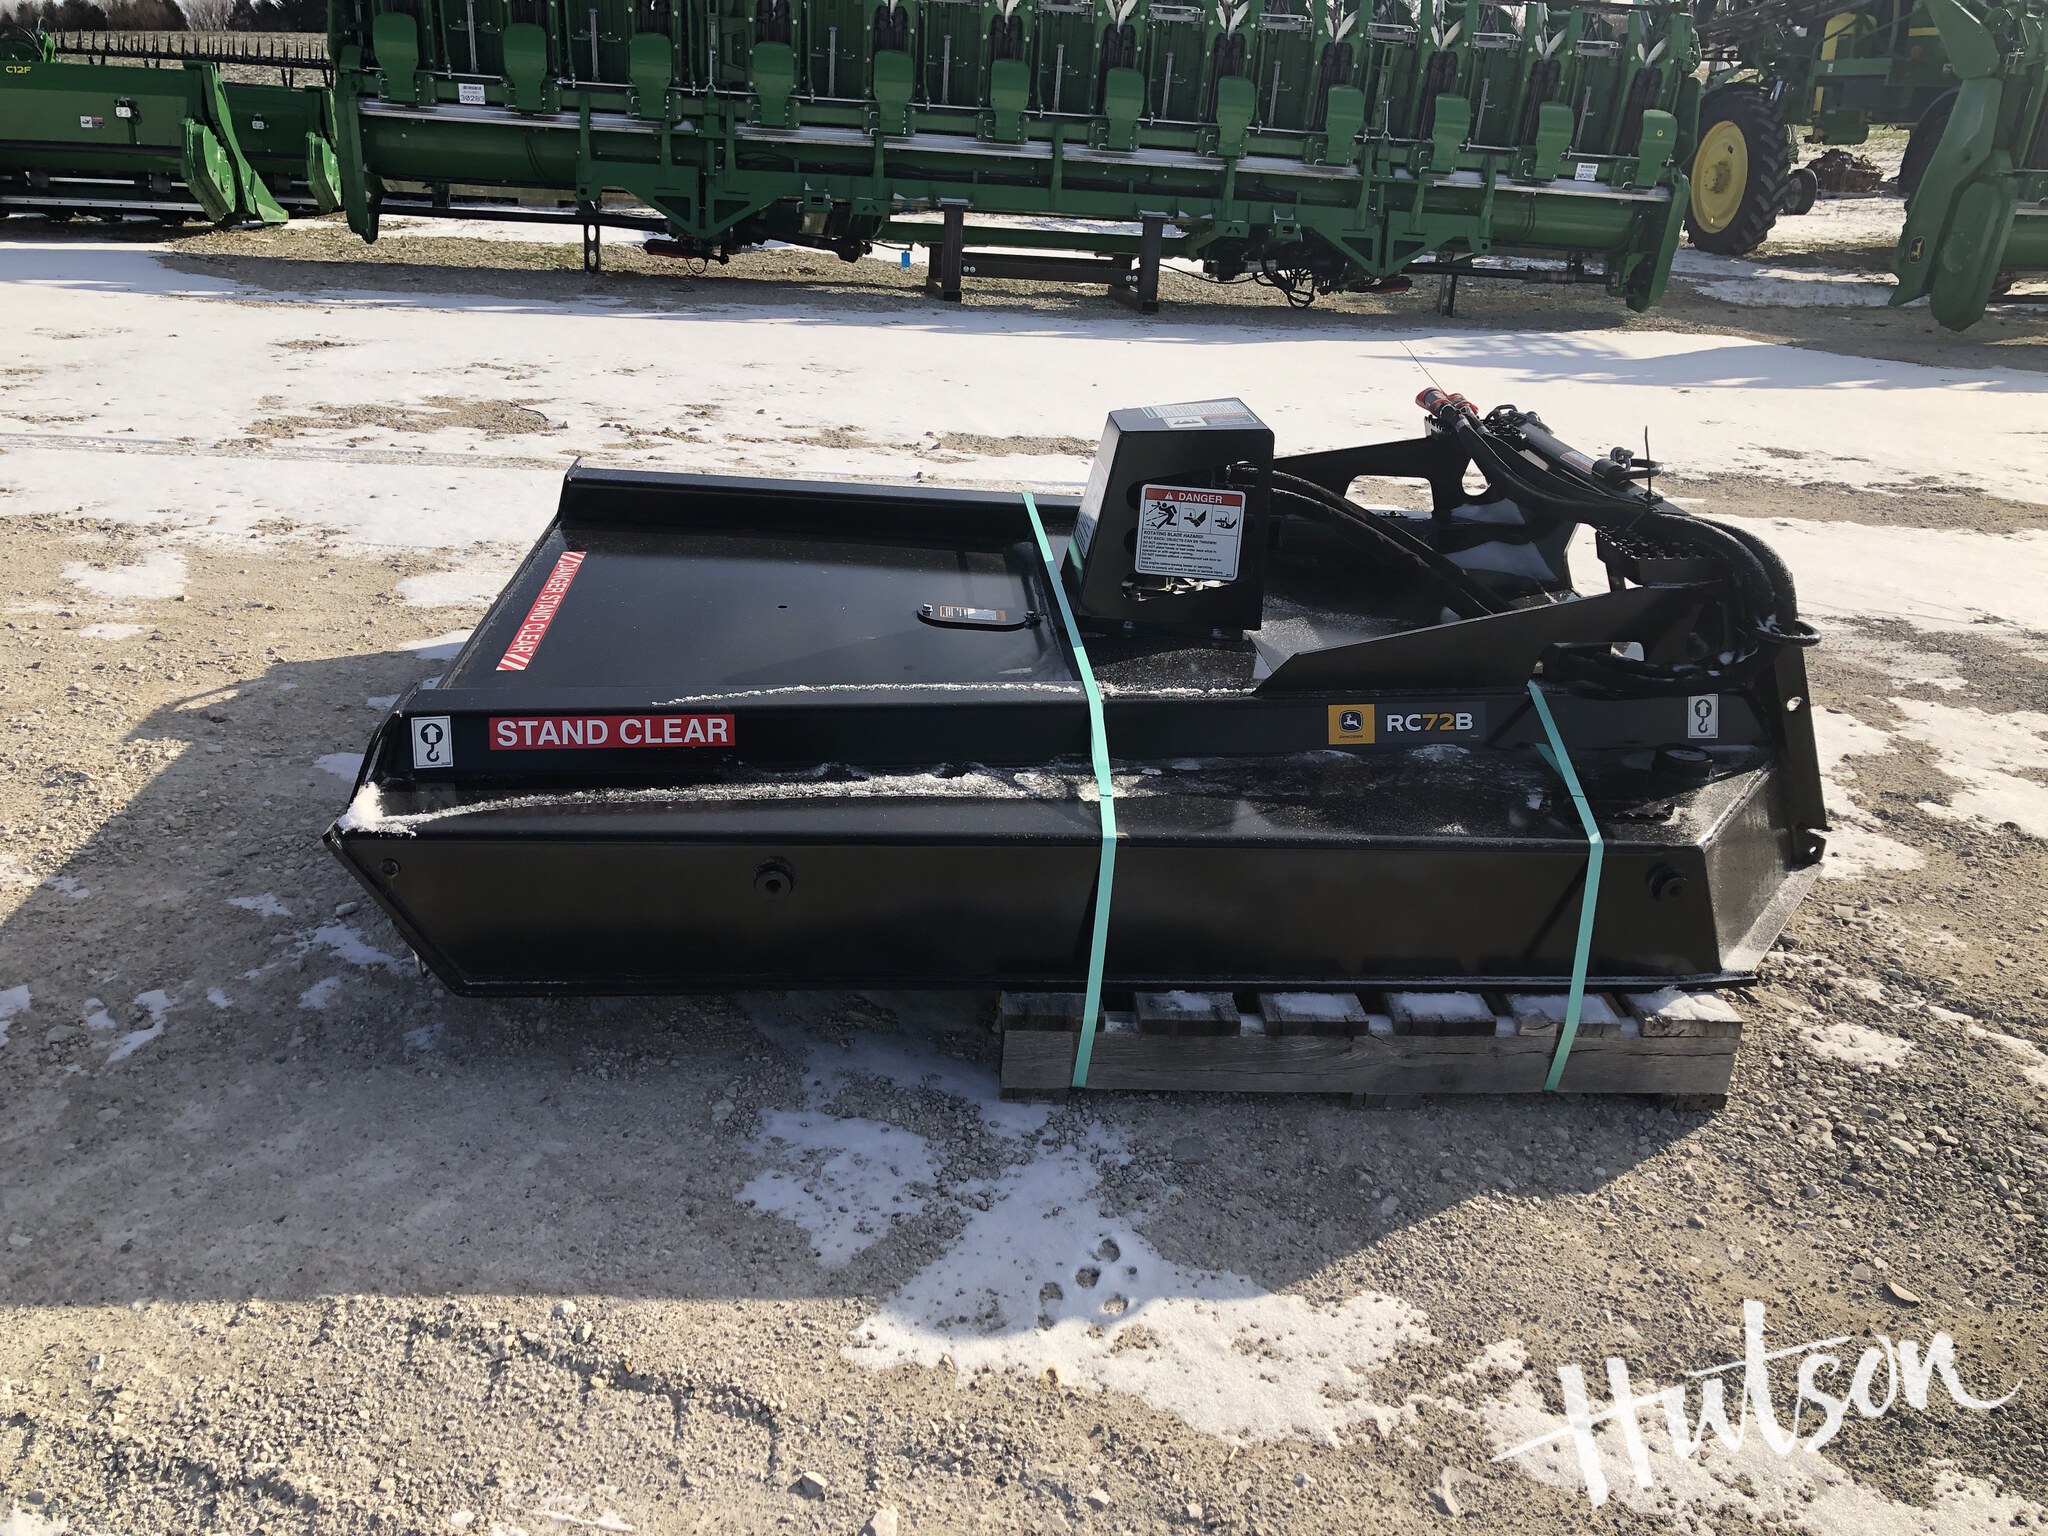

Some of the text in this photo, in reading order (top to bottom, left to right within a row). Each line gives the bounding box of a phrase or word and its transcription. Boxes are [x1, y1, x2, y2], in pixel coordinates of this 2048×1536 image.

[5, 65, 32, 74] C12F
[1178, 492, 1223, 504] DANGER
[510, 562, 580, 654] DANGER STAND CLEAR
[496, 717, 728, 747] STAND CLEAR
[1386, 712, 1474, 732] RC72B
